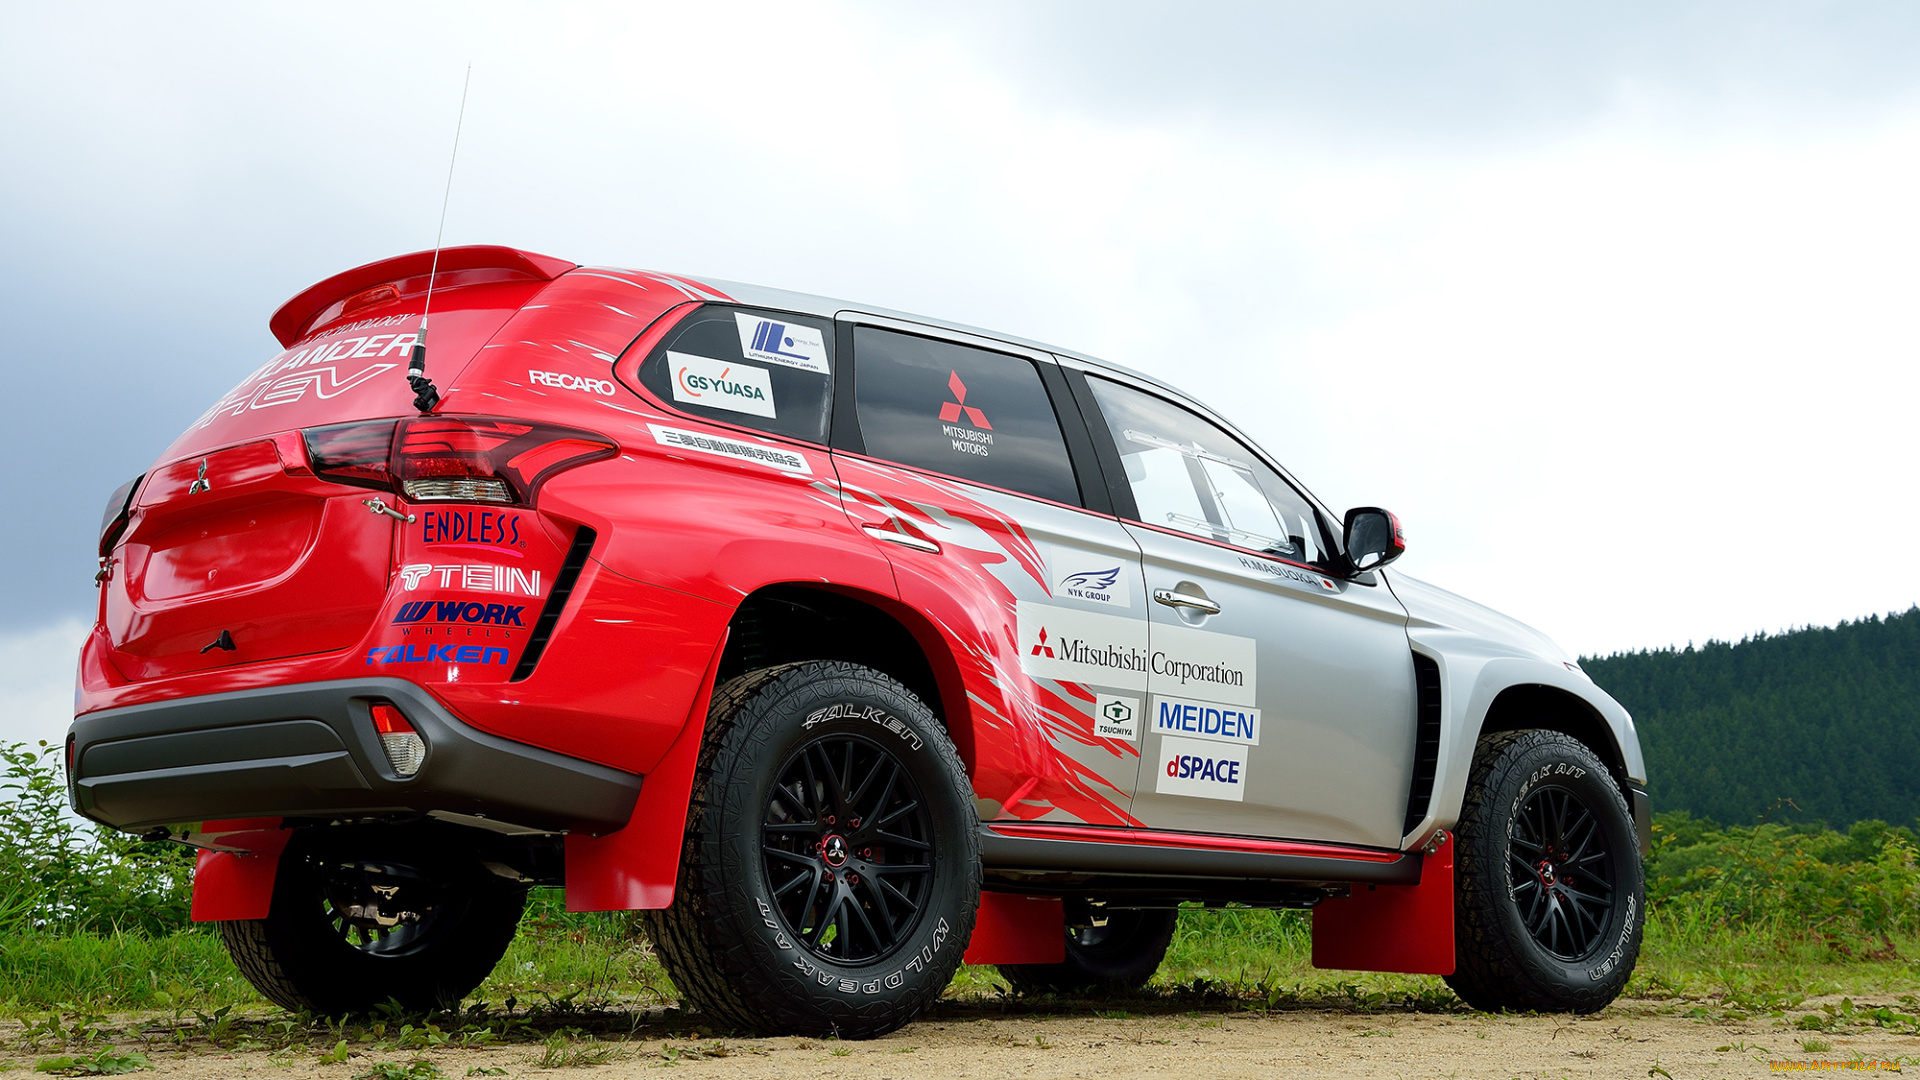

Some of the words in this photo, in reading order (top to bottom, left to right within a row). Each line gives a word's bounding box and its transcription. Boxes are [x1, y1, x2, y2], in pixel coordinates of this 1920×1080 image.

[528, 369, 616, 397] RECARO
[687, 374, 708, 390] GS
[942, 424, 994, 446] MITSUBISHI
[952, 439, 989, 457] MOTORS
[423, 511, 520, 545] ENDLESS
[434, 565, 541, 597] TEIN
[1237, 556, 1318, 586] H.MASUOKA
[1068, 588, 1084, 599] NYK
[1085, 590, 1111, 602] GROUP
[433, 602, 526, 627] WORK
[402, 627, 511, 639] WHEELS
[366, 644, 510, 666] FALKEN
[1059, 636, 1148, 673] Mitsubishi
[1151, 651, 1244, 687] Corporation
[801, 703, 924, 751] FALKEN
[1099, 725, 1133, 736] TSUCHIYA
[1159, 702, 1254, 739] MEIDEN
[1166, 755, 1240, 784] dSPACE
[794, 917, 950, 995] WILDPEAK
